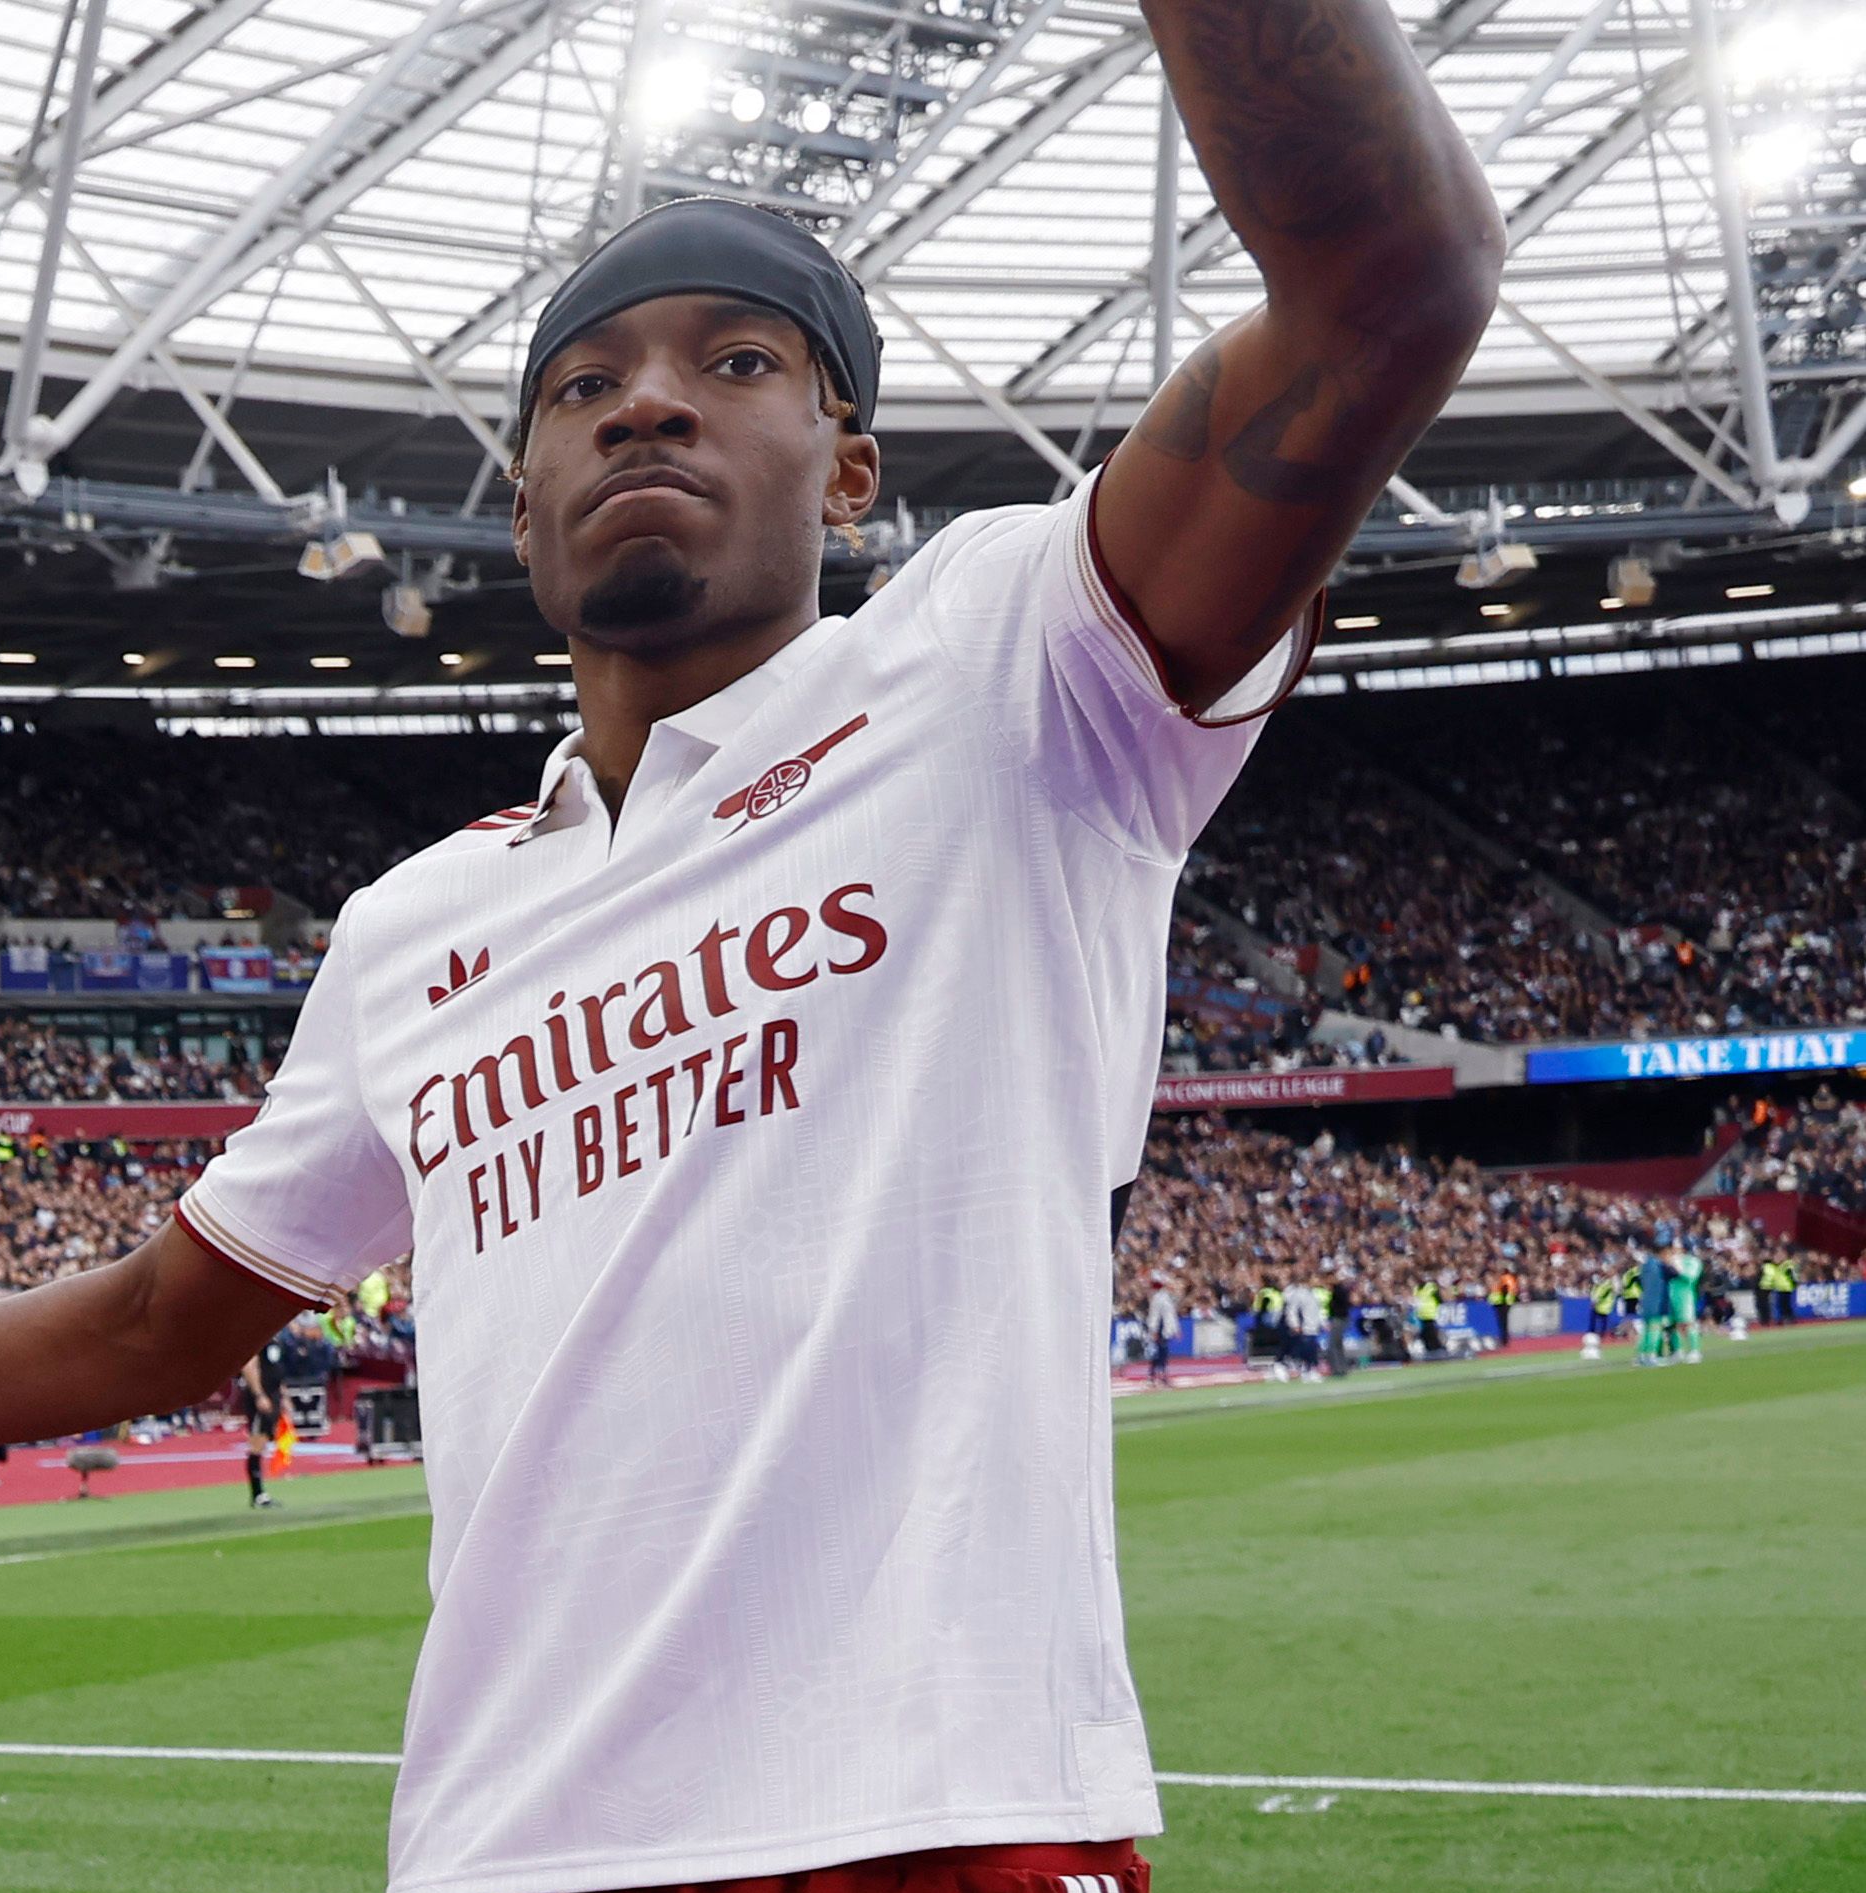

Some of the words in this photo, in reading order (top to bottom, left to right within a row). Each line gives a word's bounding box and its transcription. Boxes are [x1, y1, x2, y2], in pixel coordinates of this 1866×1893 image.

[408, 882, 888, 1182] Emirates
[467, 1130, 545, 1255] FLY
[573, 1018, 801, 1198] BETTER
[1621, 1038, 1733, 1077] TAKE
[1739, 1033, 1853, 1071] THAT
